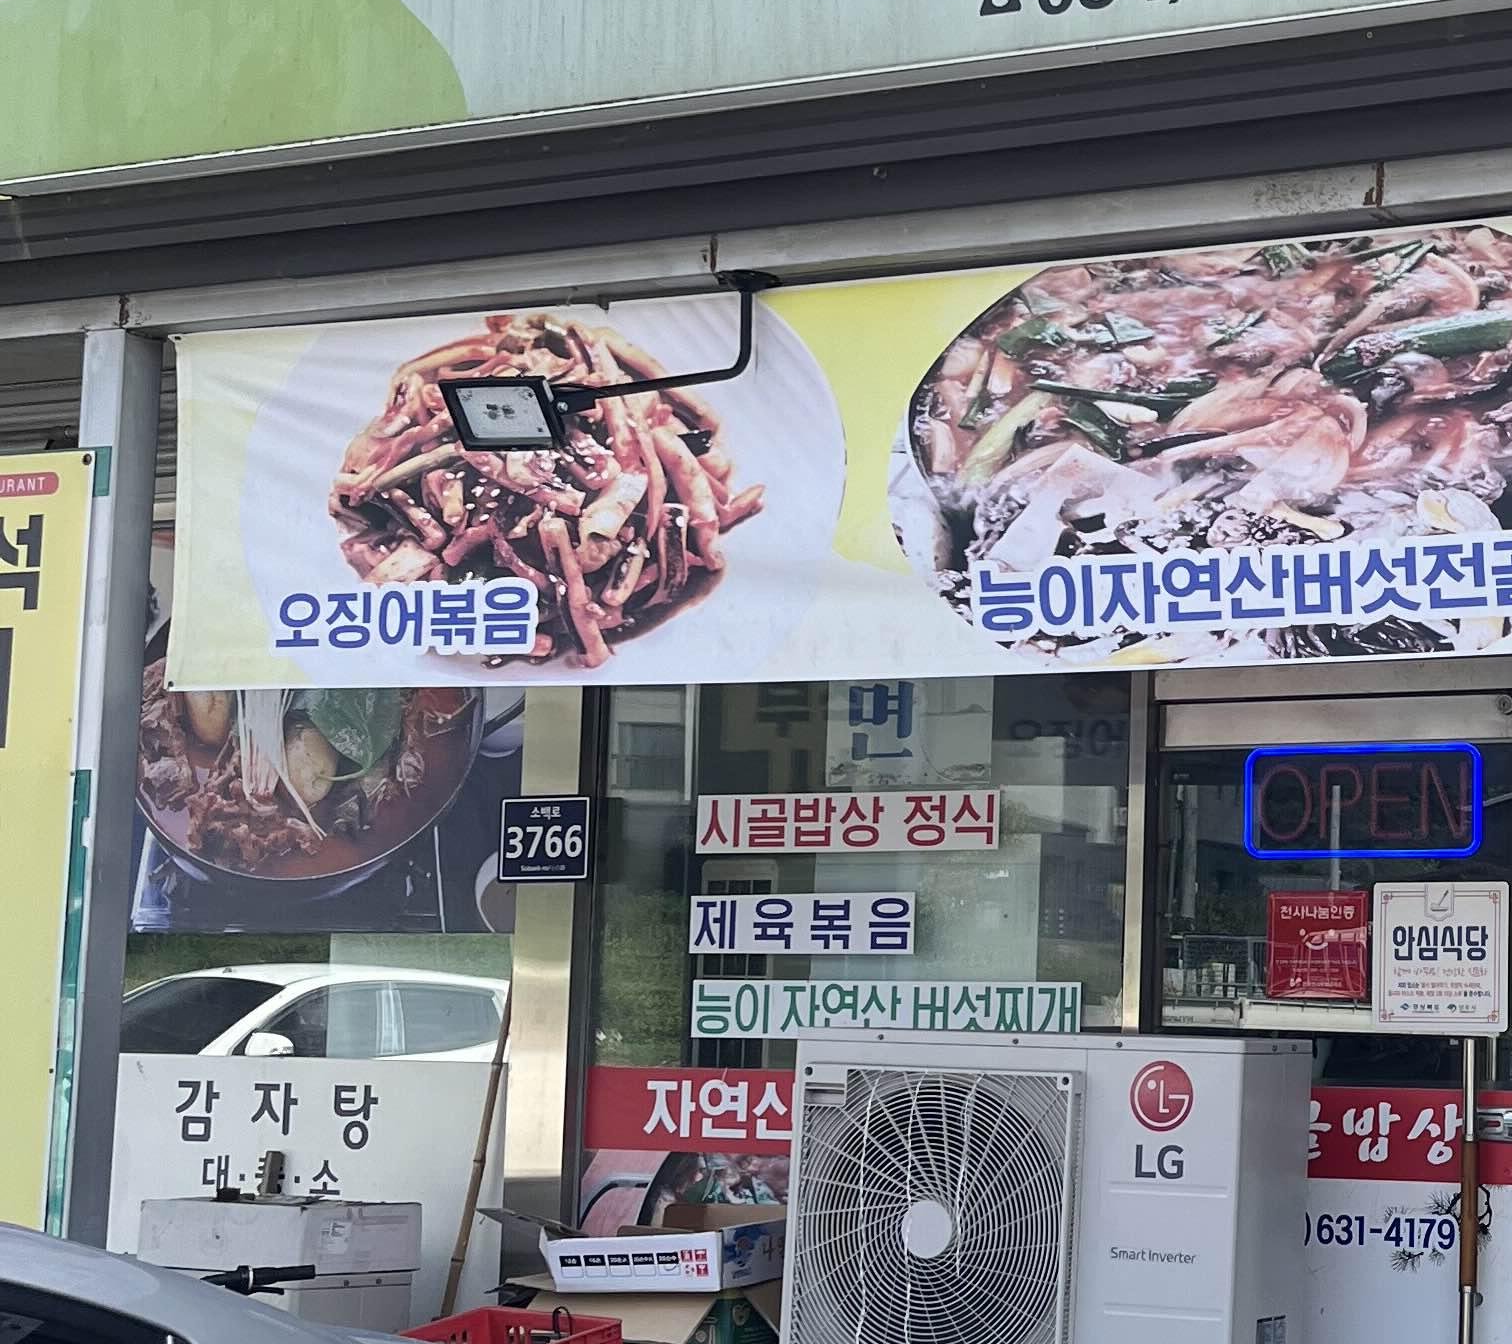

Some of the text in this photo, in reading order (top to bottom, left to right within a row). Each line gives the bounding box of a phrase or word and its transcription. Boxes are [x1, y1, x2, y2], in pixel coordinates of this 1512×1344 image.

[275, 584, 534, 649] 오징어볶음
[529, 806, 562, 820] 소백로
[700, 793, 996, 848] 시골밥상 정식
[1259, 761, 1468, 840] OPEN
[505, 824, 583, 859] 3766
[694, 897, 911, 950] 제육볶음
[1392, 925, 1489, 961] 안심식당
[696, 983, 1078, 1034] 능이 자연산 버섯찌개
[1134, 1144, 1184, 1179] LG
[1110, 1246, 1197, 1264] Smart Inverter
